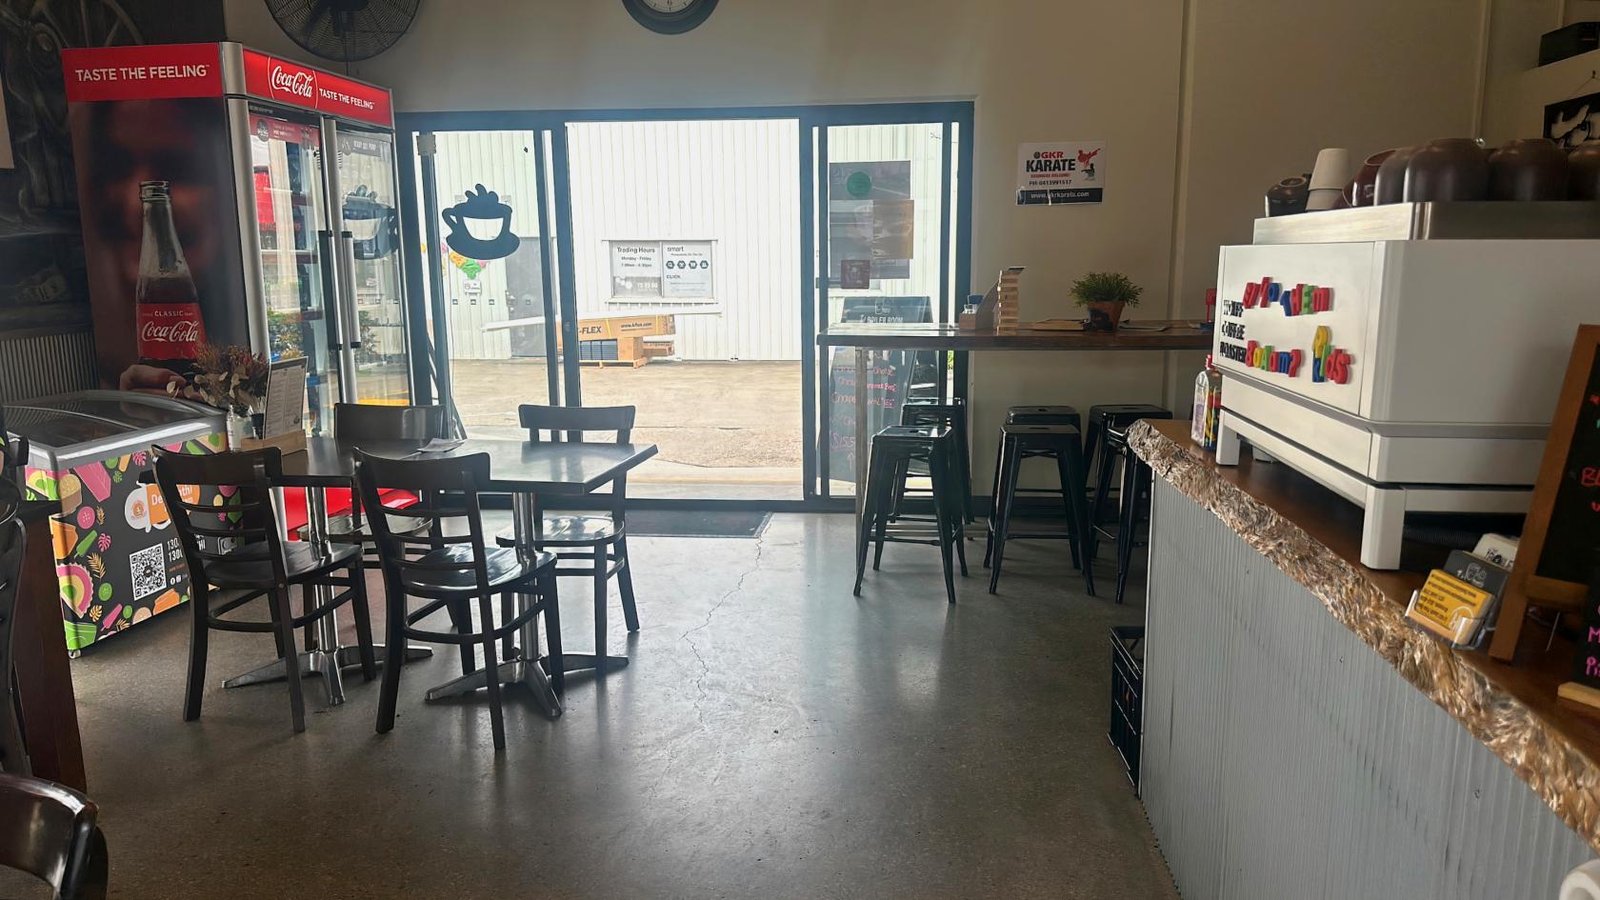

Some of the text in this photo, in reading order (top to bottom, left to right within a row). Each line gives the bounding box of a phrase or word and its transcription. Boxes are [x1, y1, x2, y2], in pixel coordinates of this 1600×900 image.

[75, 65, 208, 82] TASTE THE FEELING
[319, 88, 337, 101] TASTE
[338, 93, 351, 105] THE
[1041, 151, 1064, 159] GKR
[1026, 159, 1076, 172] KARATE
[617, 246, 656, 254] Trading Hours
